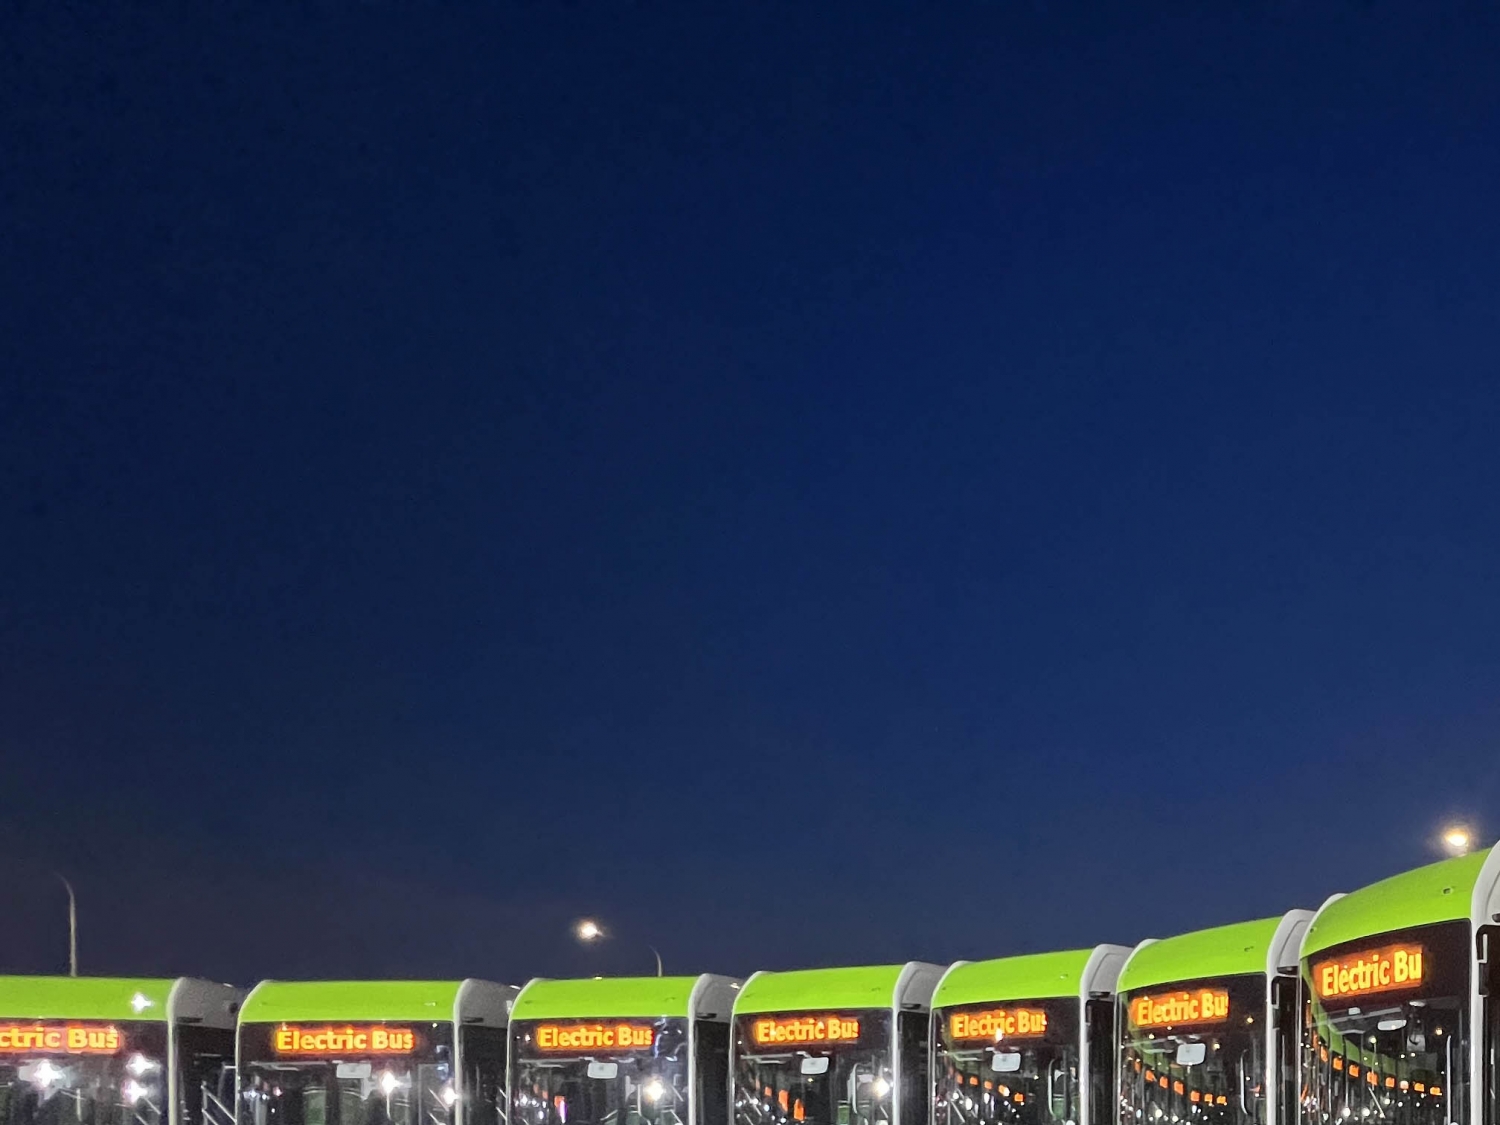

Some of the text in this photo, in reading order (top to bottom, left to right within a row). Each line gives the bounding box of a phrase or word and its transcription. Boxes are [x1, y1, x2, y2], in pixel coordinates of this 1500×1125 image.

[1322, 954, 1390, 997] Electric
[1137, 993, 1199, 1025] Electric
[540, 1025, 653, 1047] Electric Bus
[757, 1018, 825, 1042] Electric
[952, 1010, 1015, 1038] Electric
[68, 1028, 118, 1048] Bus
[277, 1029, 413, 1050] Electric Bus
